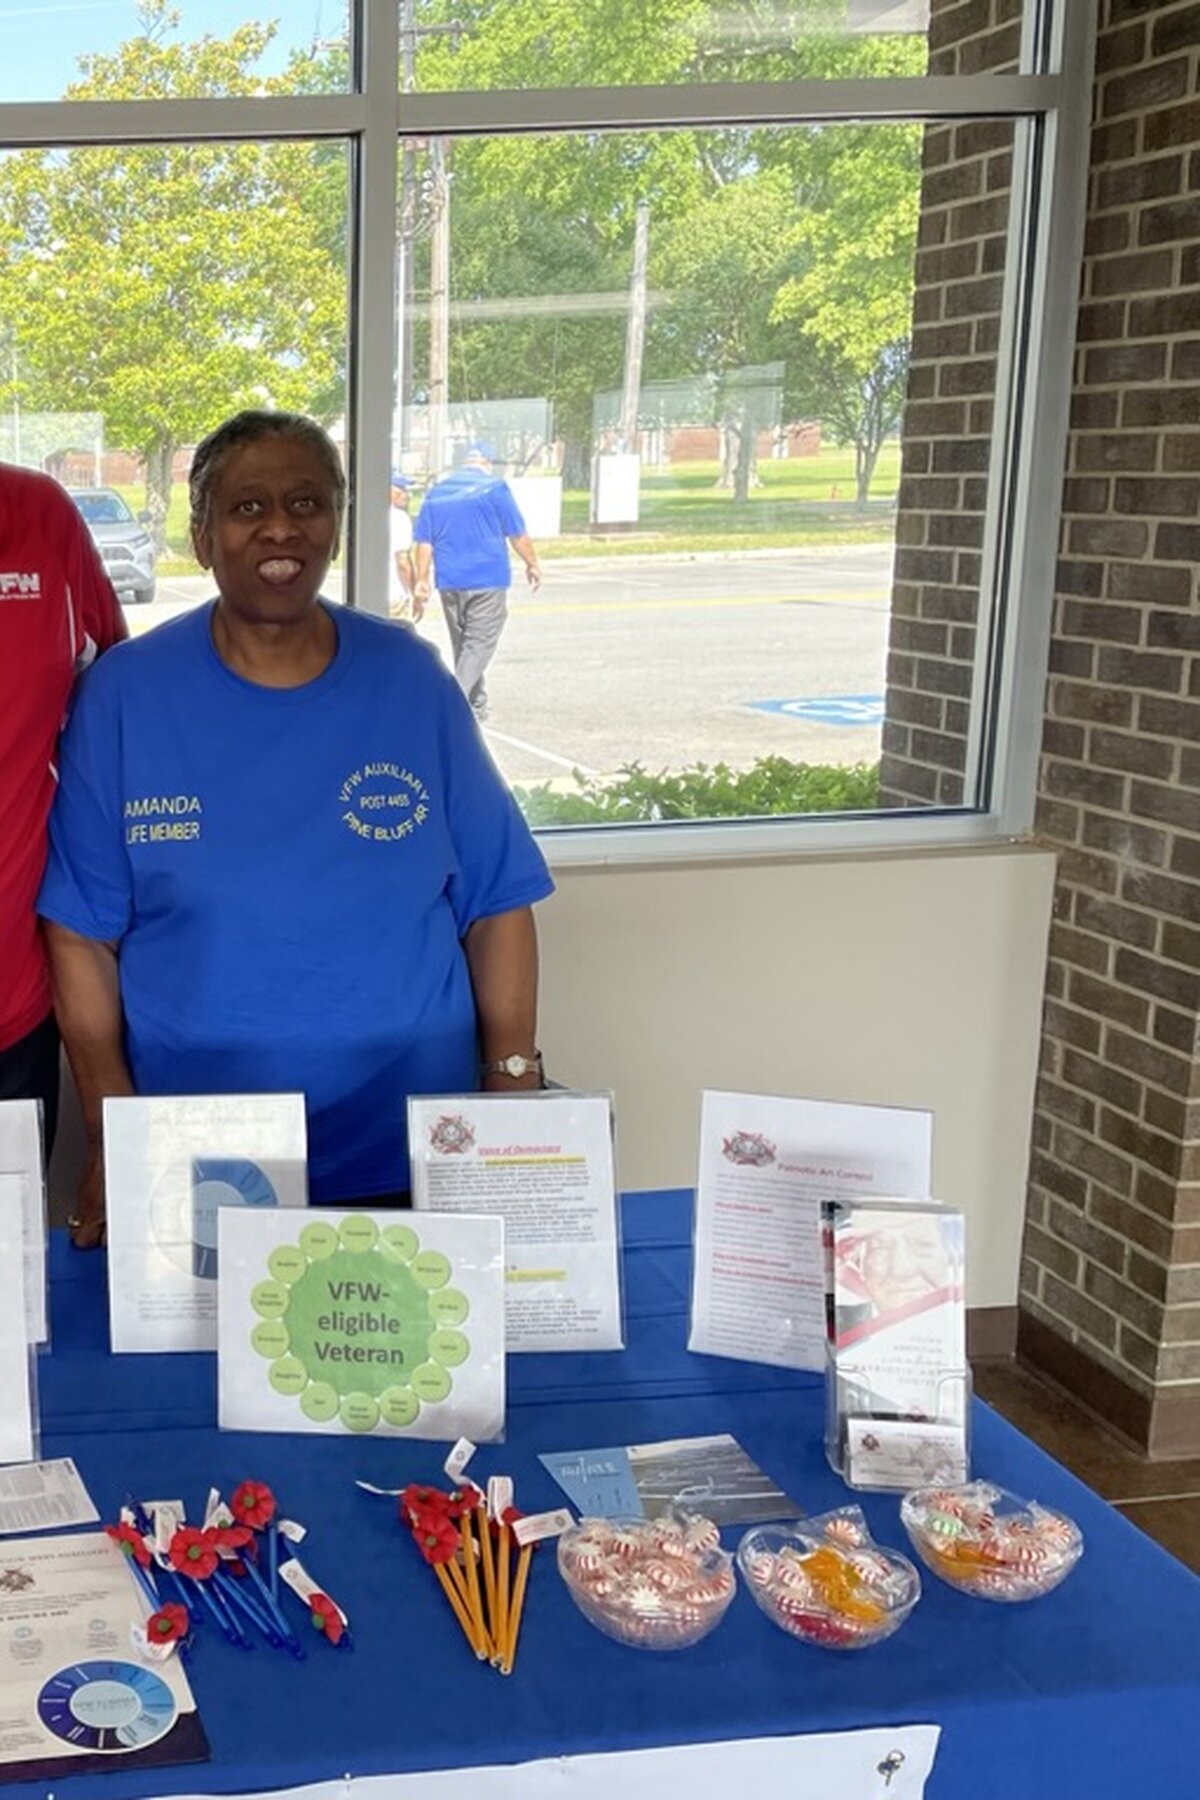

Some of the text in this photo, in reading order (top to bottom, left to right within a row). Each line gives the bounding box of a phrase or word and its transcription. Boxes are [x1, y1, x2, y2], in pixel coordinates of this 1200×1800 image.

[339, 762, 429, 803] VFW AUXILIARY
[124, 796, 202, 818] AMANDA
[360, 795, 385, 810] POST
[126, 822, 200, 844] LIFE MEMBER
[342, 803, 429, 842] PINE BLUFF AR
[328, 1280, 390, 1302] VFW-
[317, 1311, 401, 1336] eligible
[313, 1341, 405, 1365] Veteran
